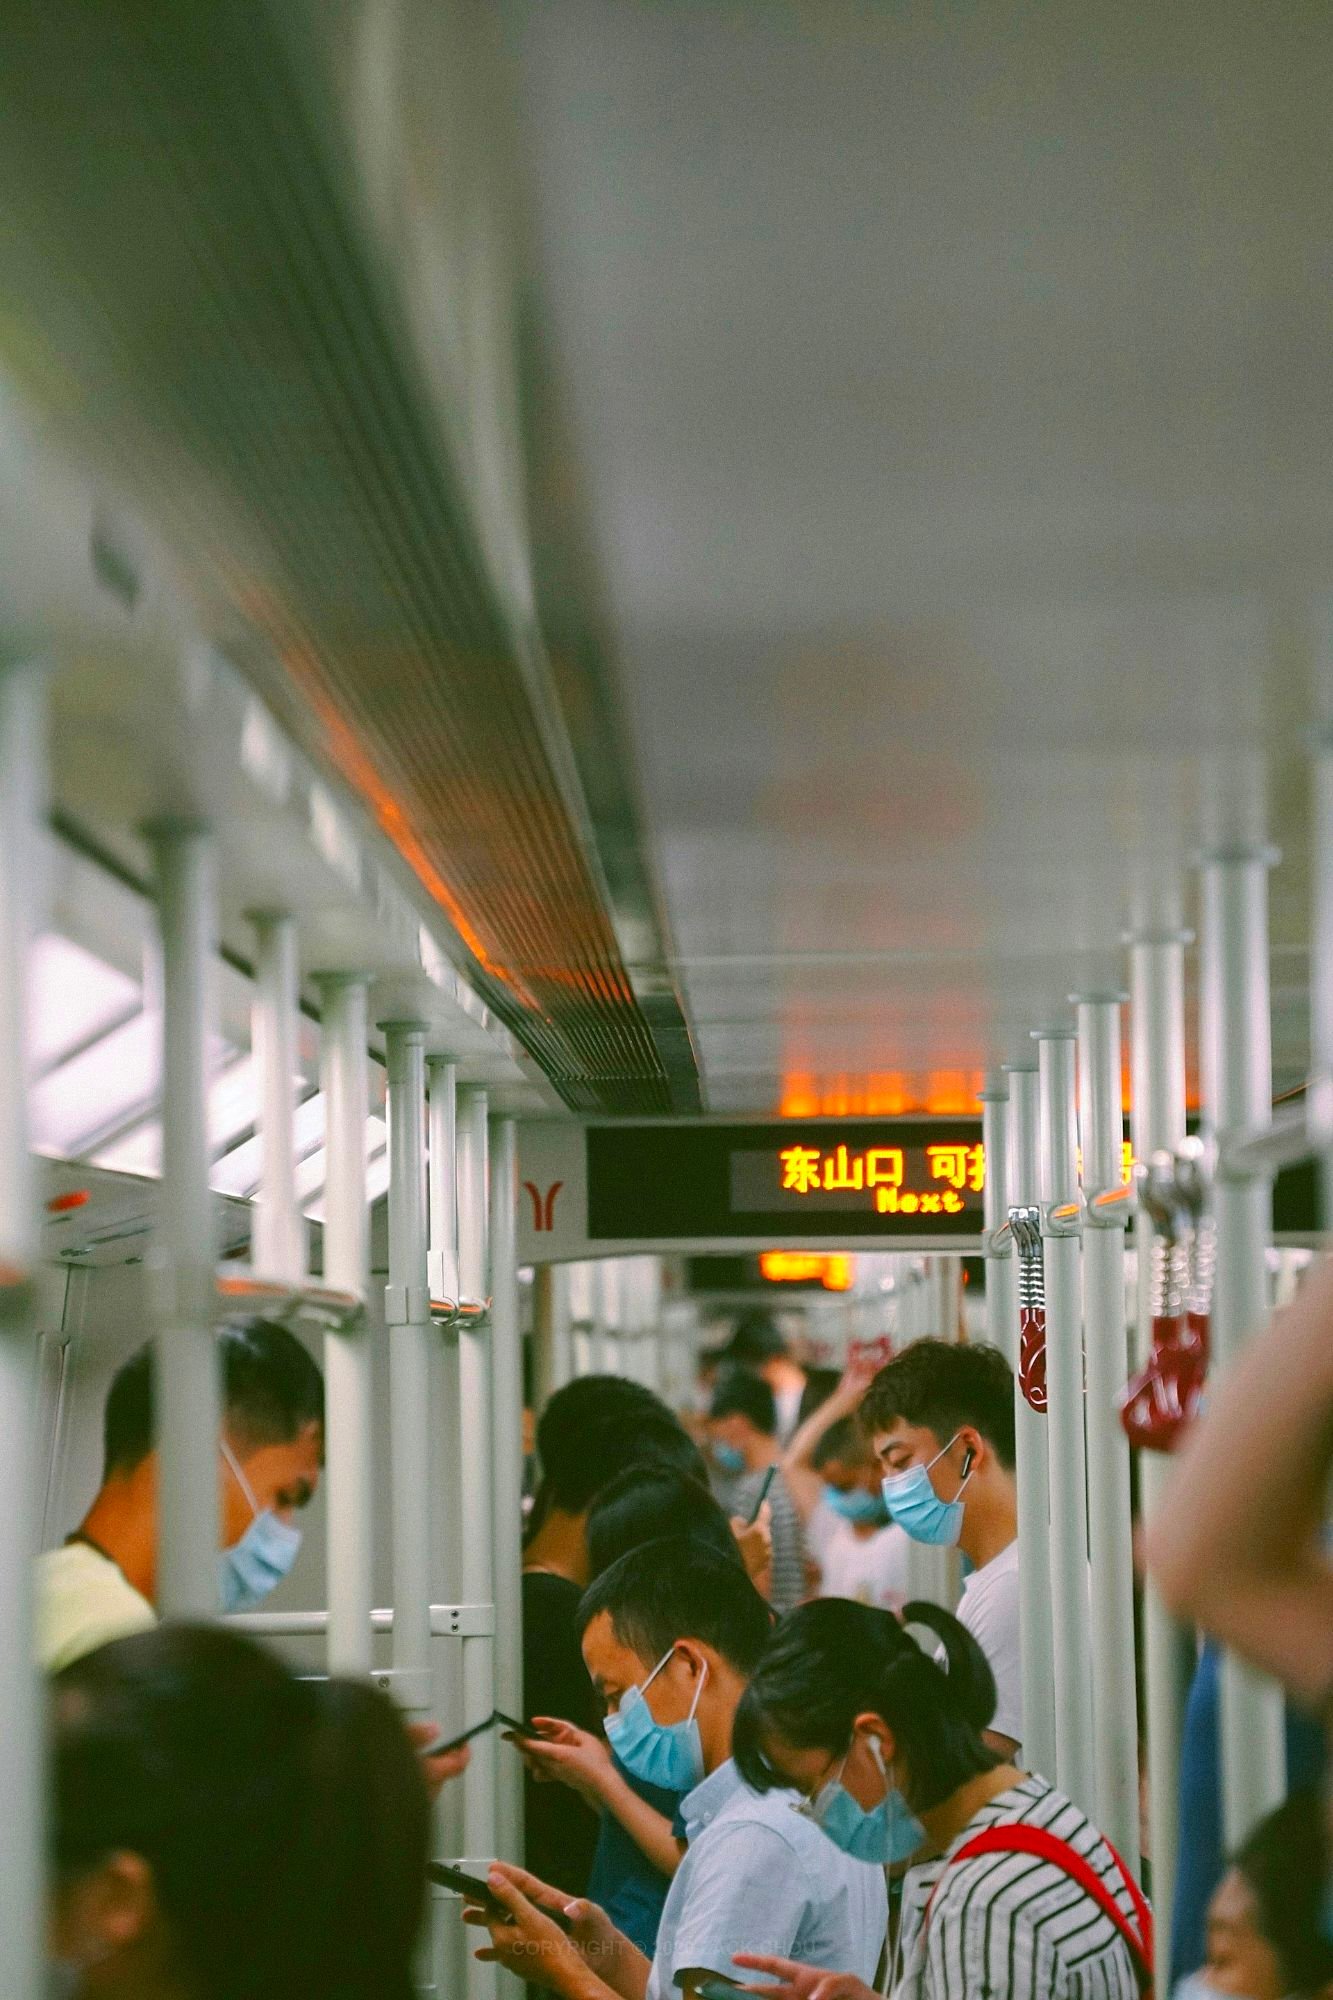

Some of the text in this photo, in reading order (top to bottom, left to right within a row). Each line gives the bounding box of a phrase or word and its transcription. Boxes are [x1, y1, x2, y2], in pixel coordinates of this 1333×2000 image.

[780, 1144, 904, 1193] 东山口
[876, 1187, 964, 1214] Next
